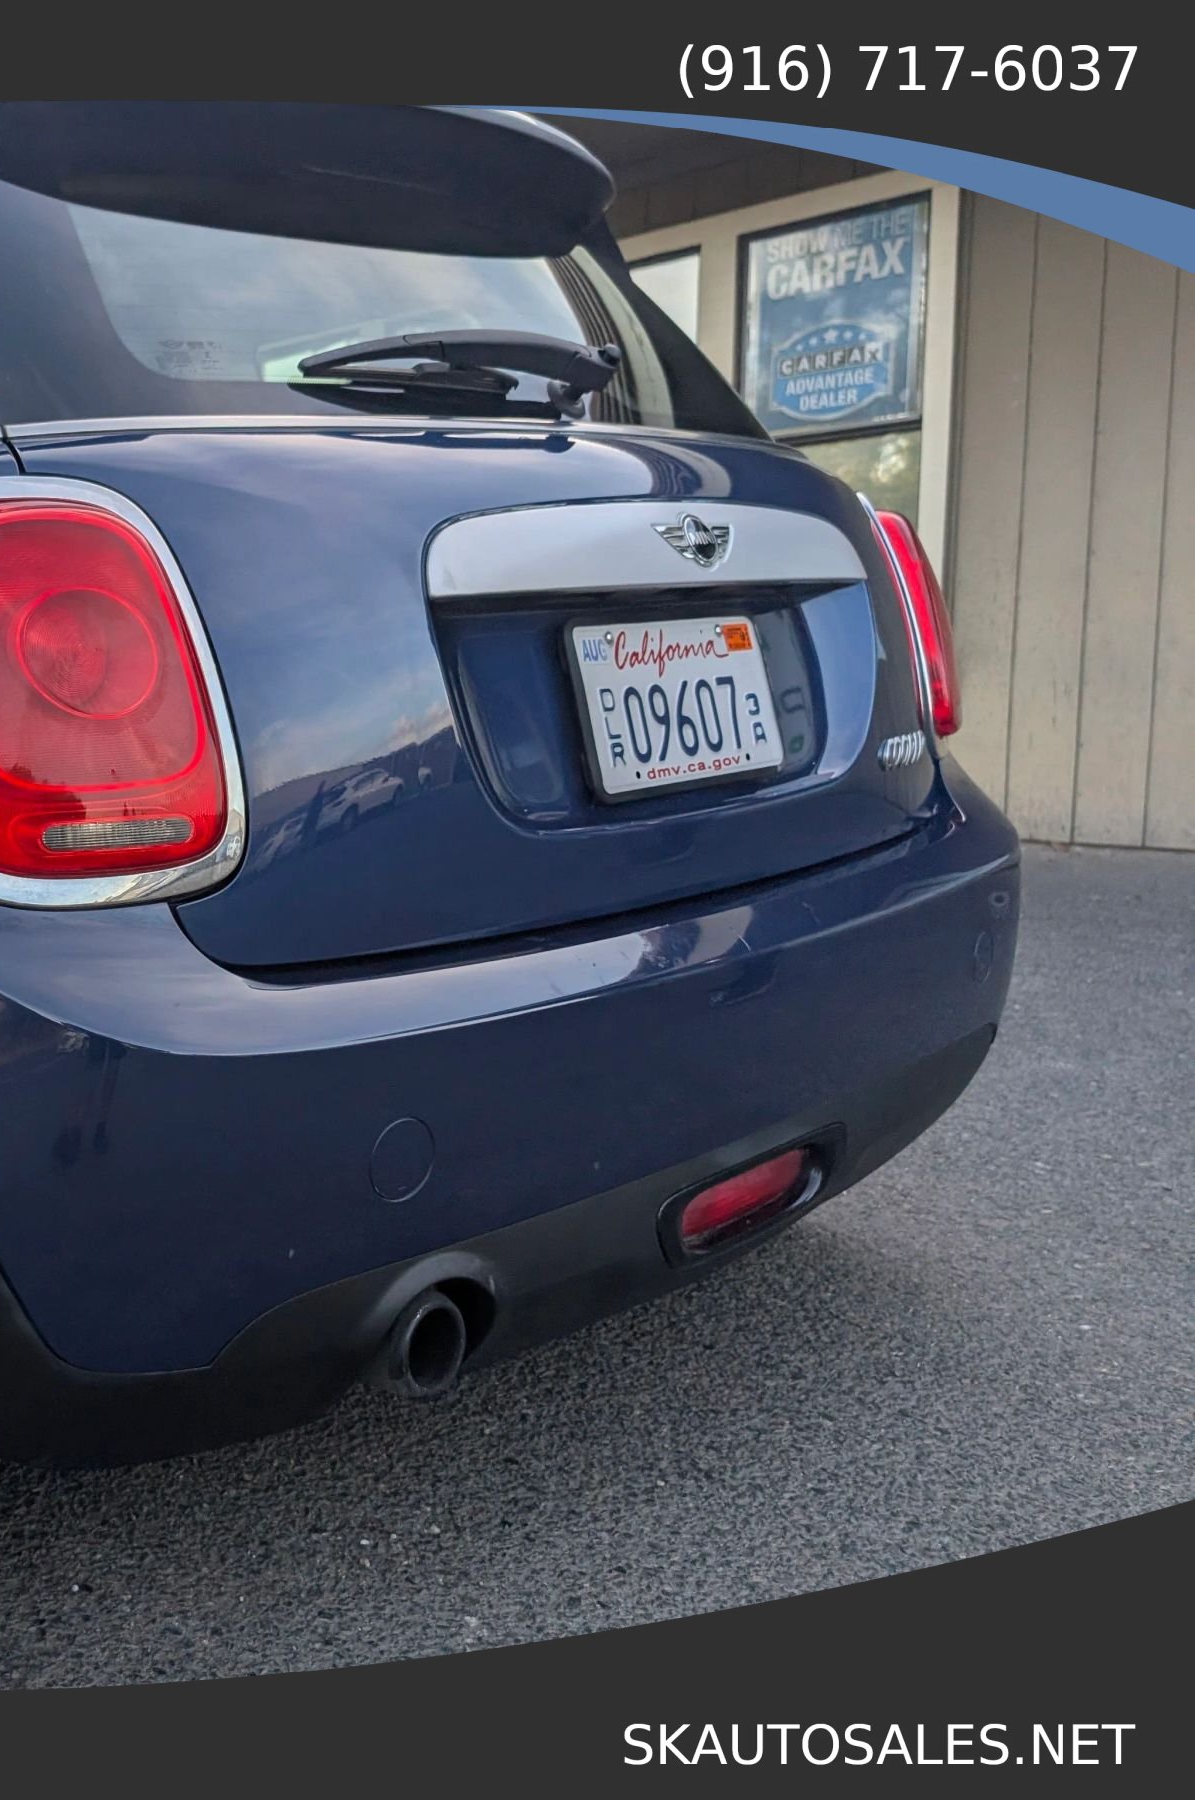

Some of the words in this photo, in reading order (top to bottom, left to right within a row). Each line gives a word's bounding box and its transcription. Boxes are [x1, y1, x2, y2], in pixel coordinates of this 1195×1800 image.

[766, 226, 829, 263] SHOW
[870, 209, 909, 240] THE
[766, 236, 910, 301] CARFAX
[781, 345, 881, 376] CARFAX
[785, 367, 875, 397] ADVANTAGE
[799, 388, 858, 411] DEALER
[581, 638, 608, 663] AUG
[614, 629, 729, 678] California
[623, 675, 743, 764] 09607
[646, 755, 742, 781] dmv.ca.gov
